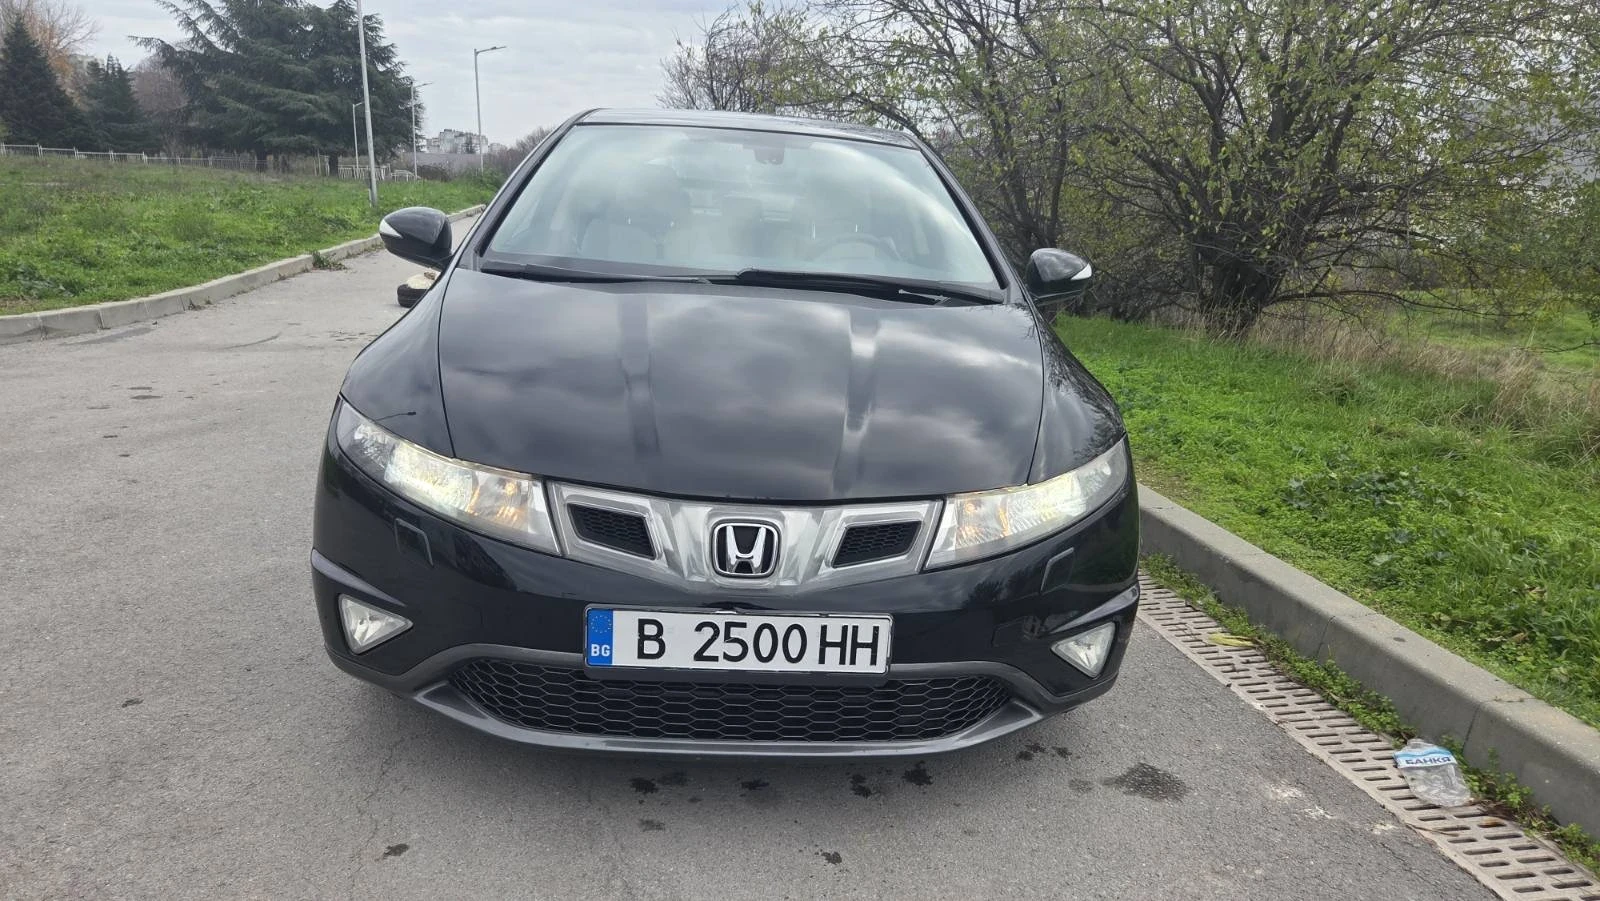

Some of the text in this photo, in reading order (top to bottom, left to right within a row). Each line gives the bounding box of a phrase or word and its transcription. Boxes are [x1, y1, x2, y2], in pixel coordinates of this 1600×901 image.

[637, 618, 880, 666] B 2500 HH
[591, 643, 610, 657] BG
[1405, 756, 1451, 765] БАНКЯ
